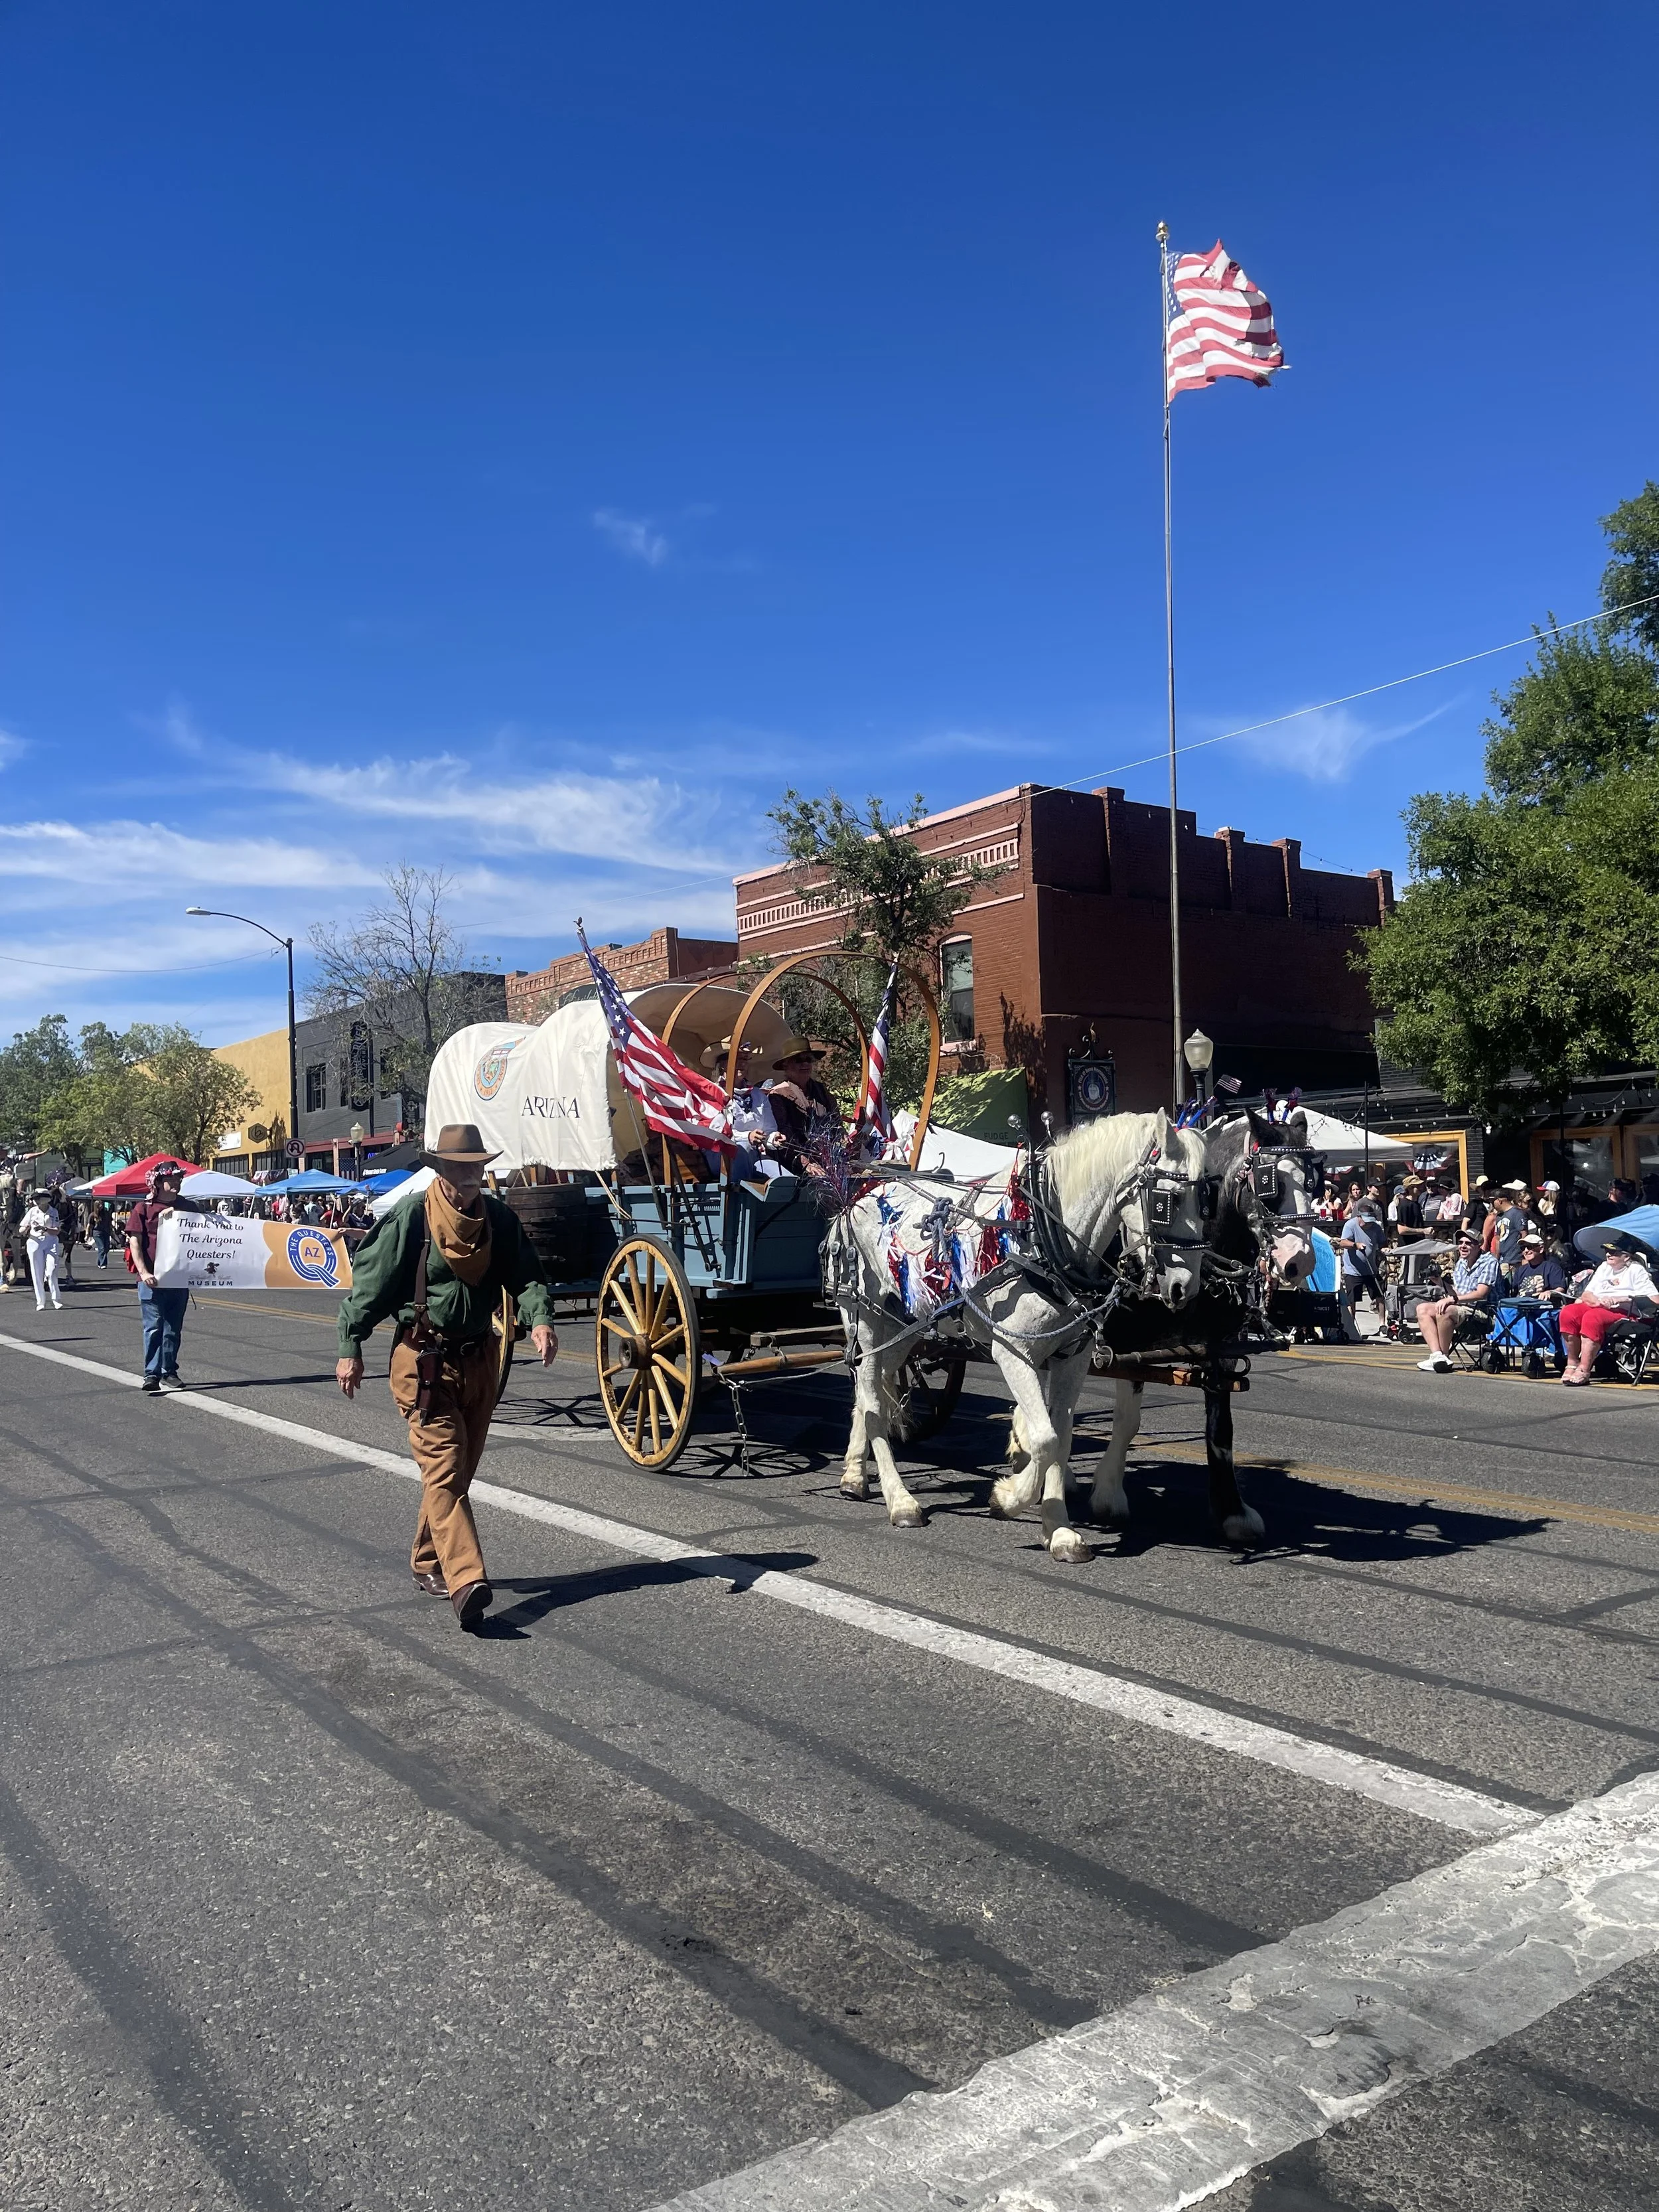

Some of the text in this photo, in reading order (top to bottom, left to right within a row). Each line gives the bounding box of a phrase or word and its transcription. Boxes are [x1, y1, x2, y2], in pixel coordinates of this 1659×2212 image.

[352, 1025, 365, 1050] RIVER
[177, 1218, 210, 1228] Thank
[212, 1220, 232, 1230] You
[179, 1233, 242, 1246] The Arizona
[289, 1230, 334, 1256] THE QUESTERS
[186, 1250, 236, 1260] Questers!
[305, 1247, 321, 1258] AZ
